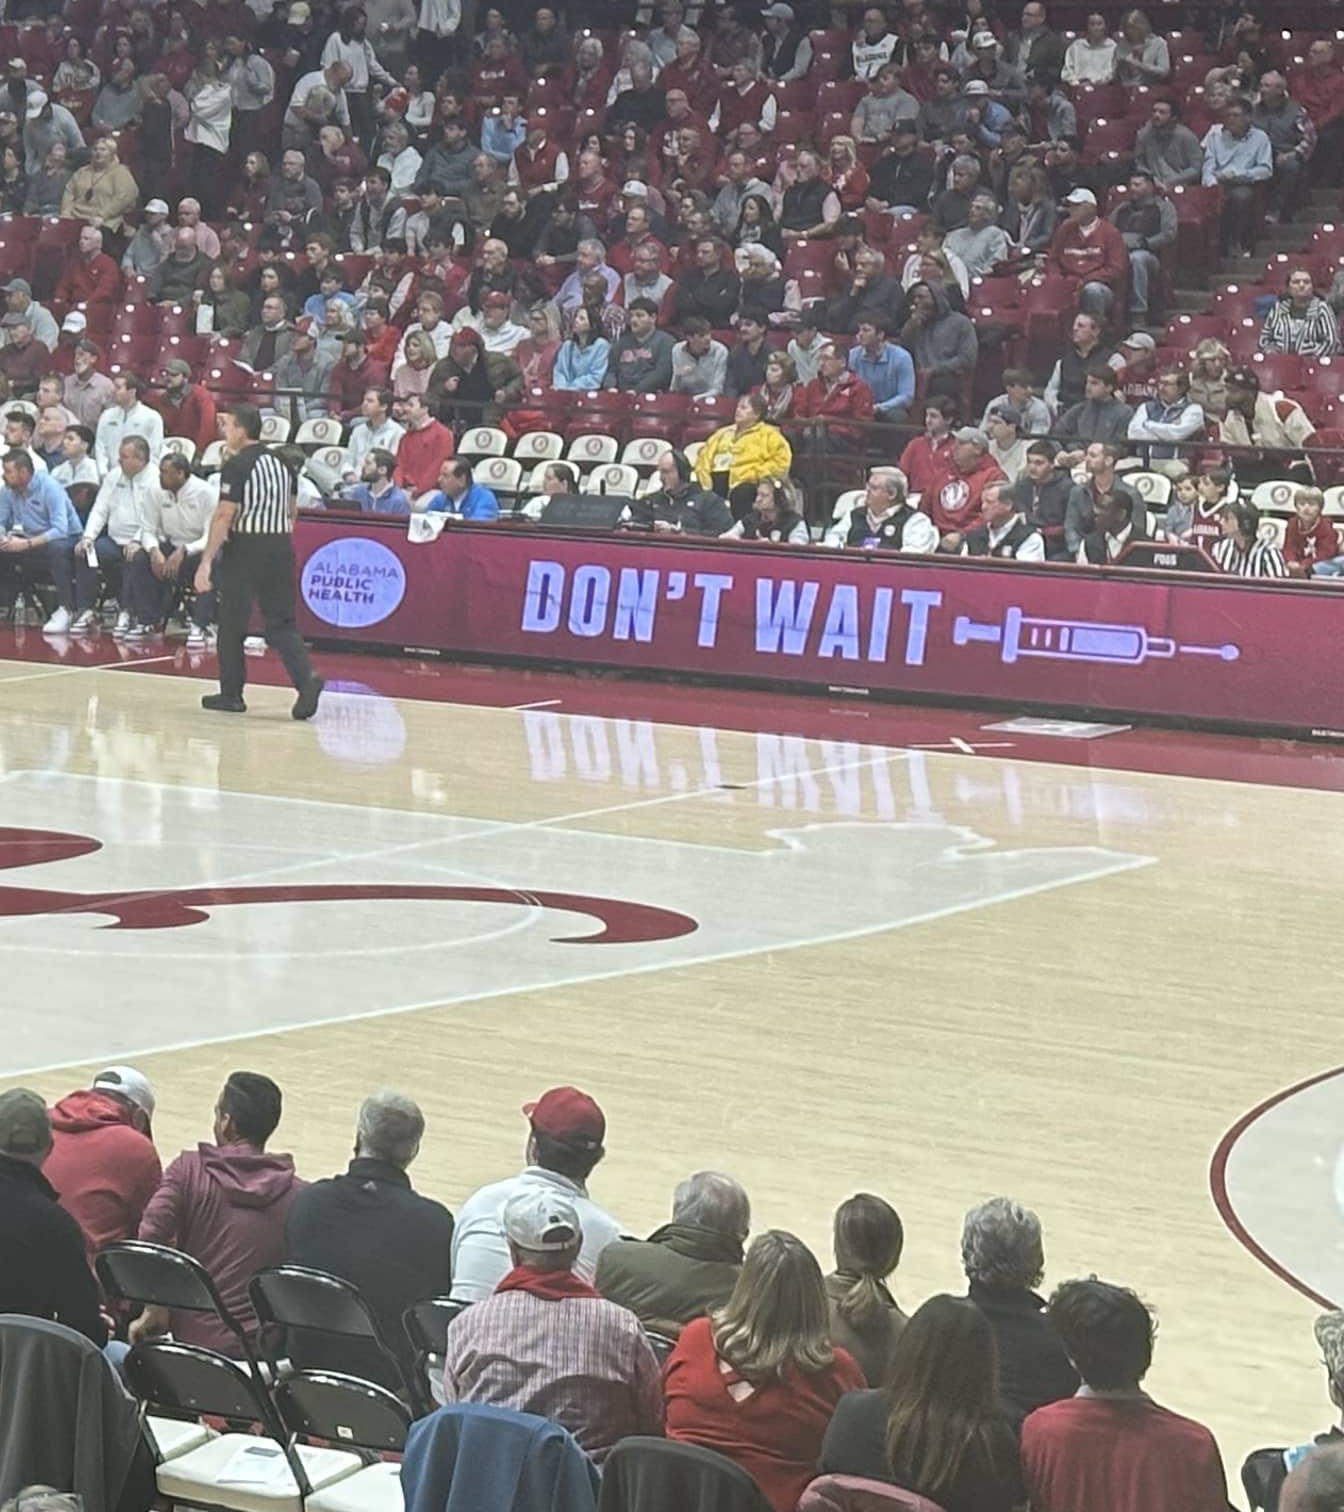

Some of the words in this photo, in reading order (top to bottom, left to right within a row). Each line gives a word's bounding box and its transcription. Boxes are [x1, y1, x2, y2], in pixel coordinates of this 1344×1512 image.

[313, 561, 399, 579] ALABAMA
[310, 574, 374, 591] PUBLIC
[308, 588, 375, 605] HEALTH
[521, 560, 733, 648] DON'T
[755, 578, 942, 665] WAIT
